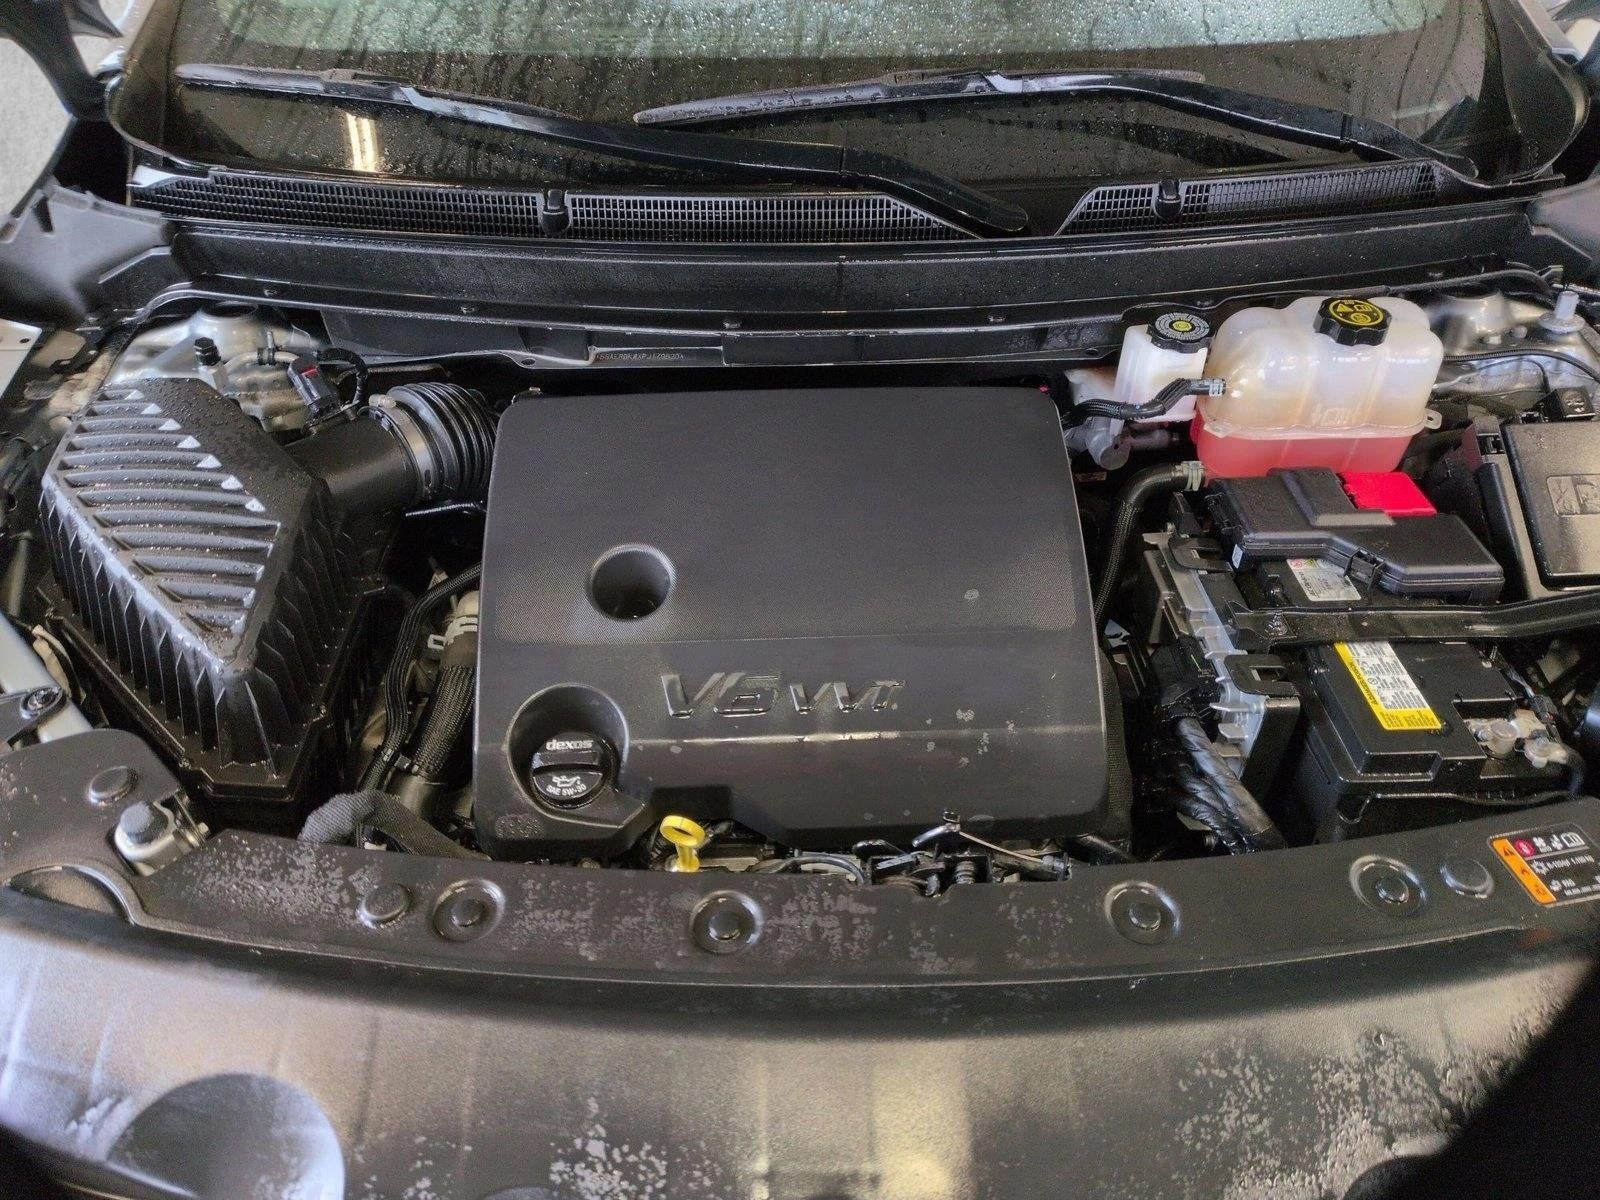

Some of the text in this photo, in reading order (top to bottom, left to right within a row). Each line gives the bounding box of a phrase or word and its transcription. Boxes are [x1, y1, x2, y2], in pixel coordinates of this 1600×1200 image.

[661, 672, 781, 719] V6
[545, 739, 594, 751] dexos
[545, 783, 587, 796] SAE 5W-30
